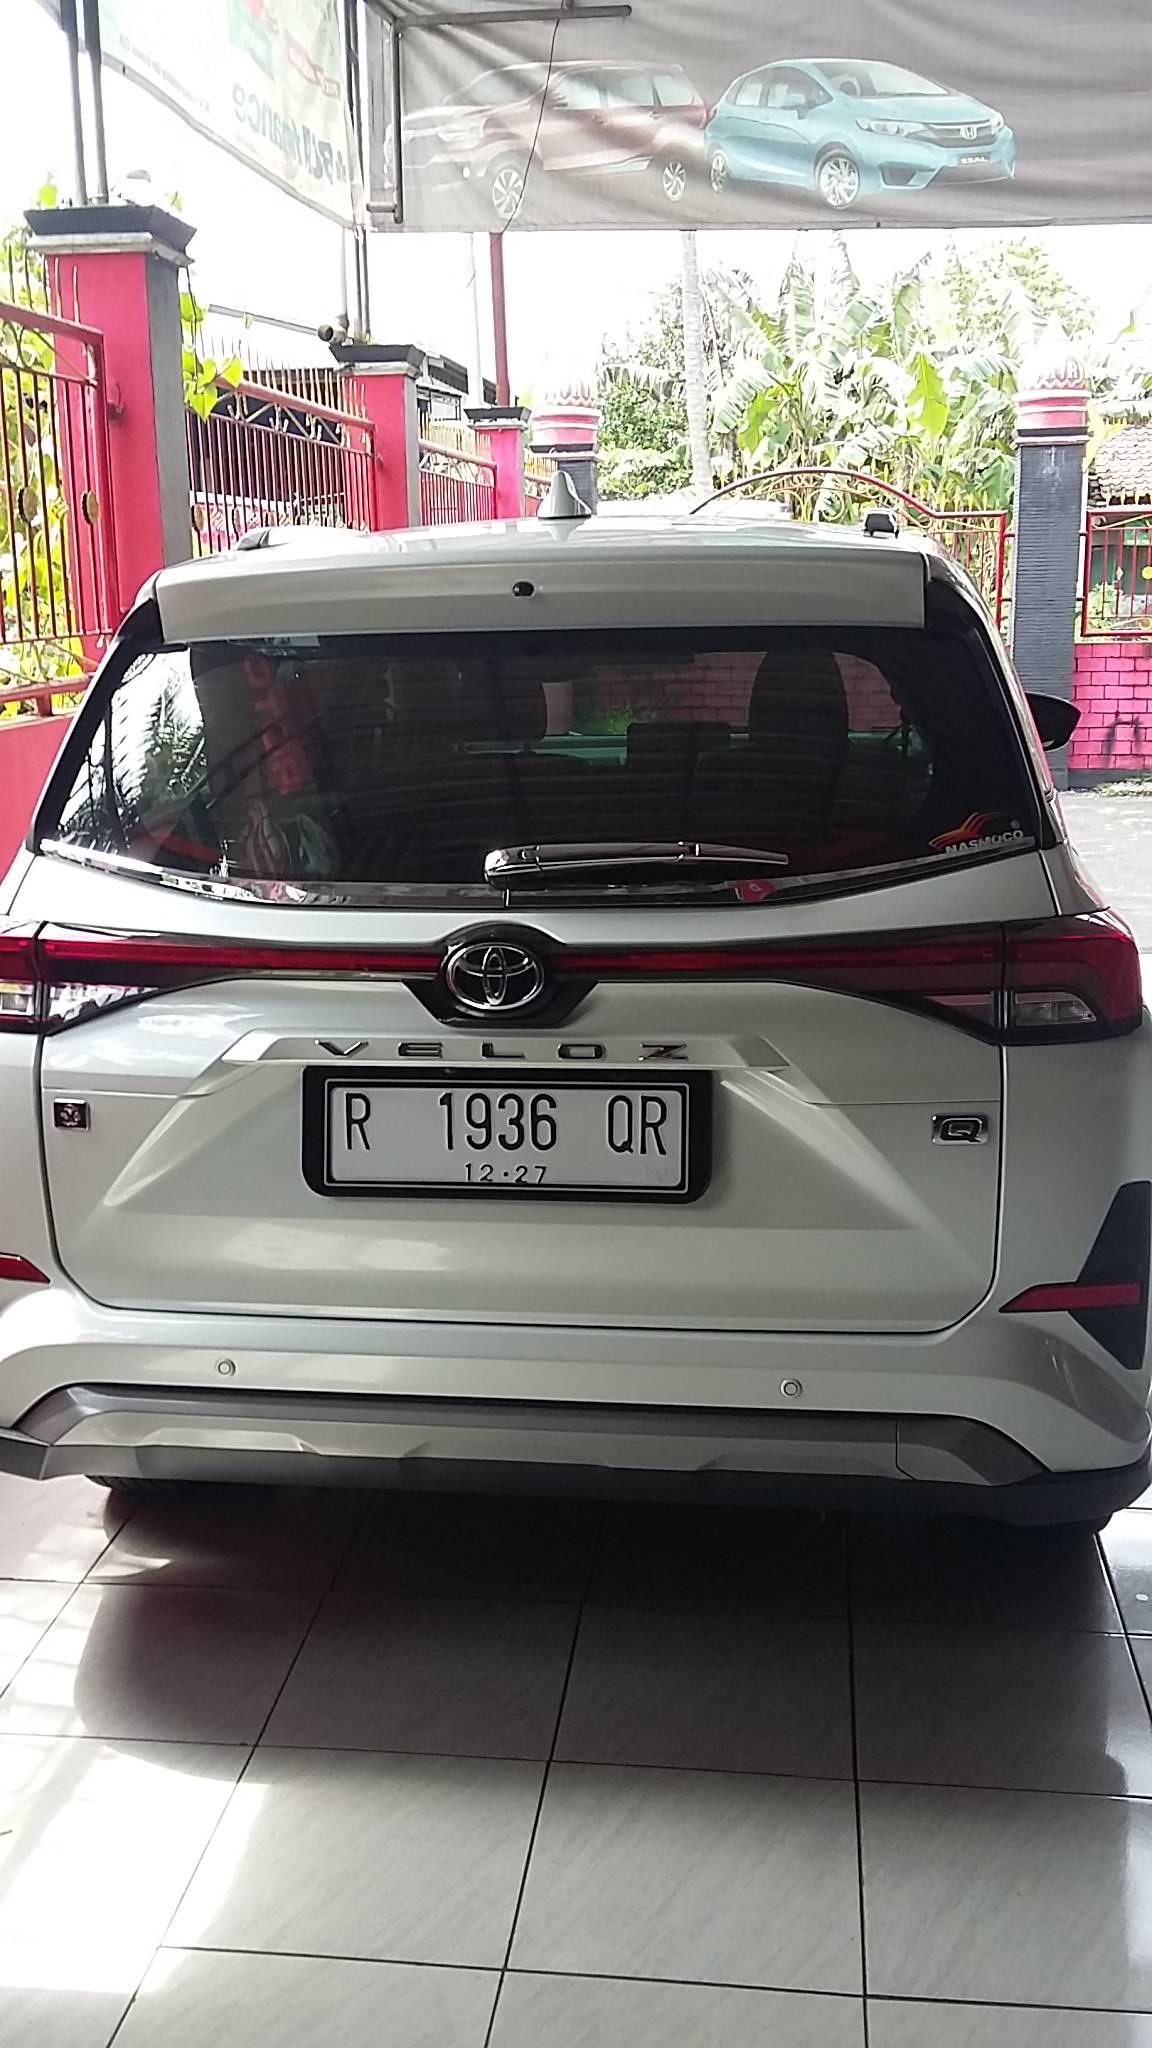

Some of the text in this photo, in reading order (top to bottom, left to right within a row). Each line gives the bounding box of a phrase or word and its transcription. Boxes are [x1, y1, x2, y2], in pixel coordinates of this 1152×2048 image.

[945, 829, 1024, 854] NASMOCO
[314, 1039, 689, 1061] VELOZ
[344, 1092, 668, 1156] R 1936 QR
[938, 1115, 985, 1144] Q
